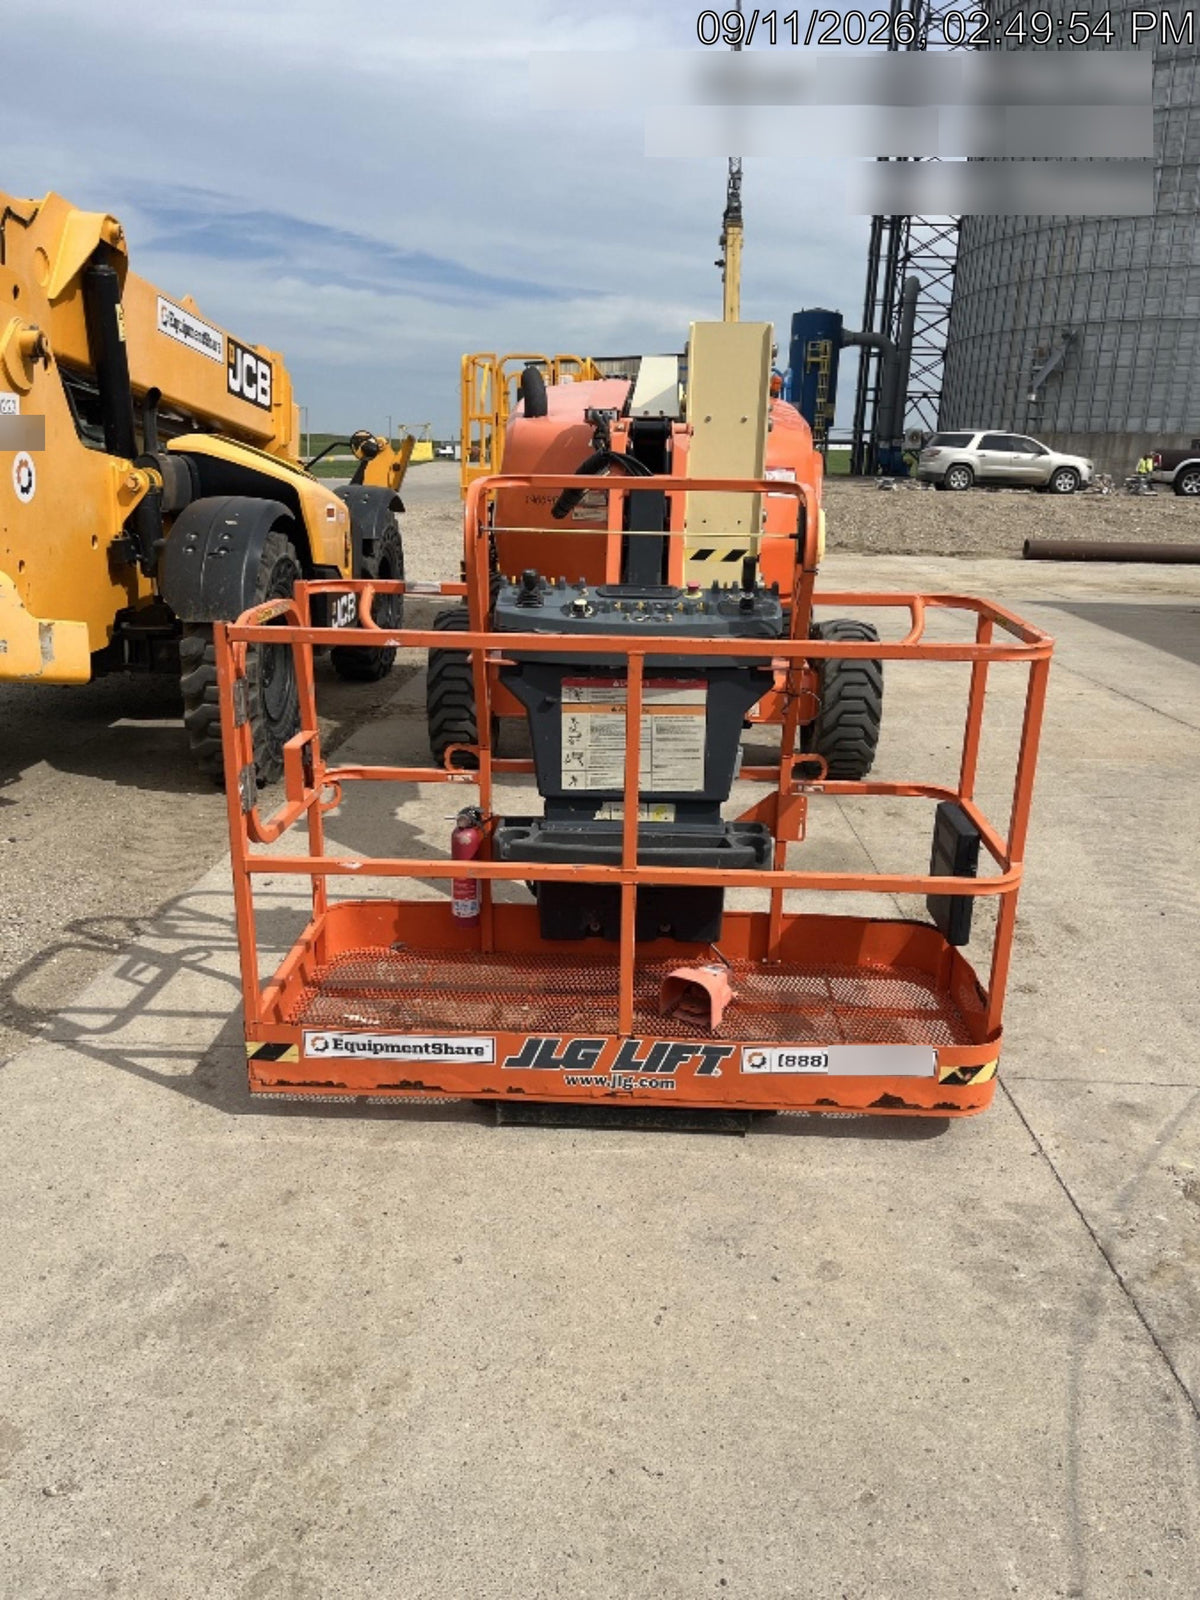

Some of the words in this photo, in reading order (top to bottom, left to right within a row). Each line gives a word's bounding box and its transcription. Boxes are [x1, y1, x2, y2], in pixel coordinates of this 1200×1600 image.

[228, 347, 271, 407] JCB
[332, 592, 356, 628] JCB
[332, 1038, 485, 1056] EquipmentShare
[501, 1037, 608, 1071] JLG
[610, 1038, 736, 1077] LIFT
[778, 1053, 829, 1068] (888)
[564, 1074, 676, 1090] www.jlg.com
